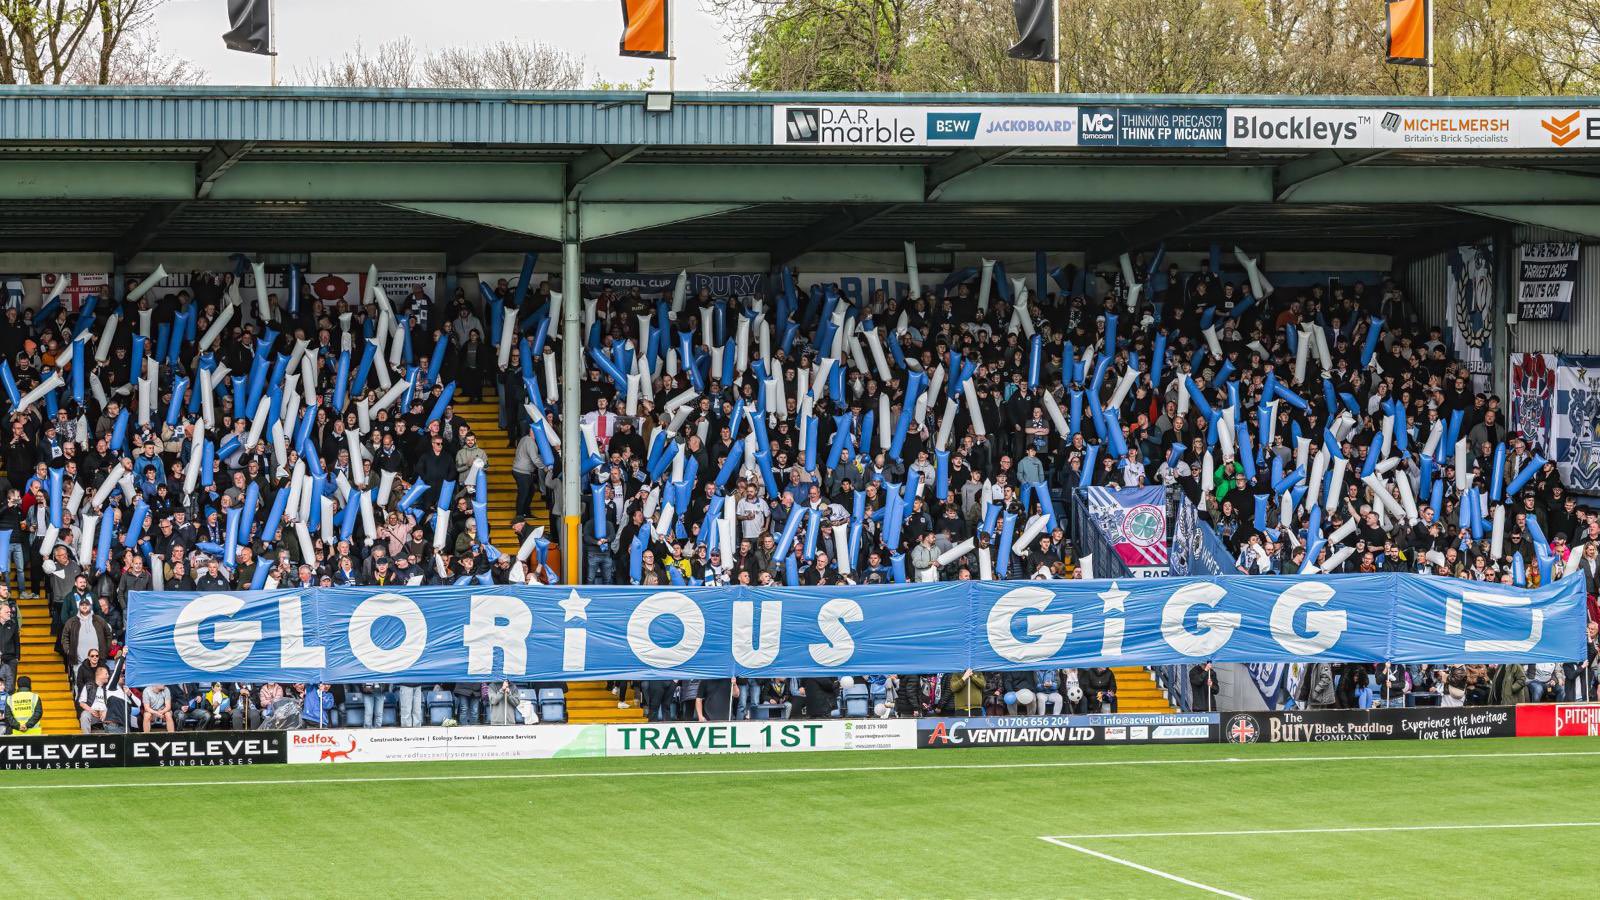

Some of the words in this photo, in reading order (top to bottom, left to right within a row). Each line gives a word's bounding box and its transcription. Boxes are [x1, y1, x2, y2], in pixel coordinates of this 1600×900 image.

[821, 109, 869, 124] D.A.R
[1122, 114, 1169, 127] THINKING
[1172, 114, 1222, 127] PRECAST?
[821, 117, 915, 144] marble
[935, 120, 970, 132] BEWI
[1404, 118, 1509, 131] MICHELMERSH
[1082, 133, 1114, 141] fpmccann
[1122, 127, 1155, 140] THINK
[1158, 127, 1172, 140] FP
[1174, 127, 1222, 140] MCCANN
[1404, 134, 1437, 143] Britain's
[1440, 134, 1460, 143] Brick
[1463, 134, 1508, 144] Specialists
[695, 274, 761, 297] BURY
[997, 717, 1028, 726] 01706
[1031, 717, 1049, 726] 656
[1052, 717, 1069, 726] 204
[1103, 715, 1210, 725] info@acventilation.com
[1284, 713, 1302, 722] The
[1401, 717, 1450, 732] Experience
[1453, 715, 1468, 726] the
[1471, 711, 1507, 724] heritage
[968, 728, 1065, 743] VENTILATION
[1068, 727, 1095, 741] LTD
[1162, 725, 1208, 736] DAIKIN
[1270, 717, 1312, 742] Bury
[1315, 724, 1345, 734] Black
[1348, 723, 1393, 736] Pudding
[1442, 728, 1457, 739] the
[1459, 725, 1492, 739] flavour
[293, 735, 335, 745] Redfox
[432, 735, 452, 743] Ecology
[617, 726, 751, 750] TRAVEL
[760, 724, 823, 748] 1ST
[1315, 734, 1370, 742] COMPANY
[160, 758, 253, 767] SUNGLASSES
